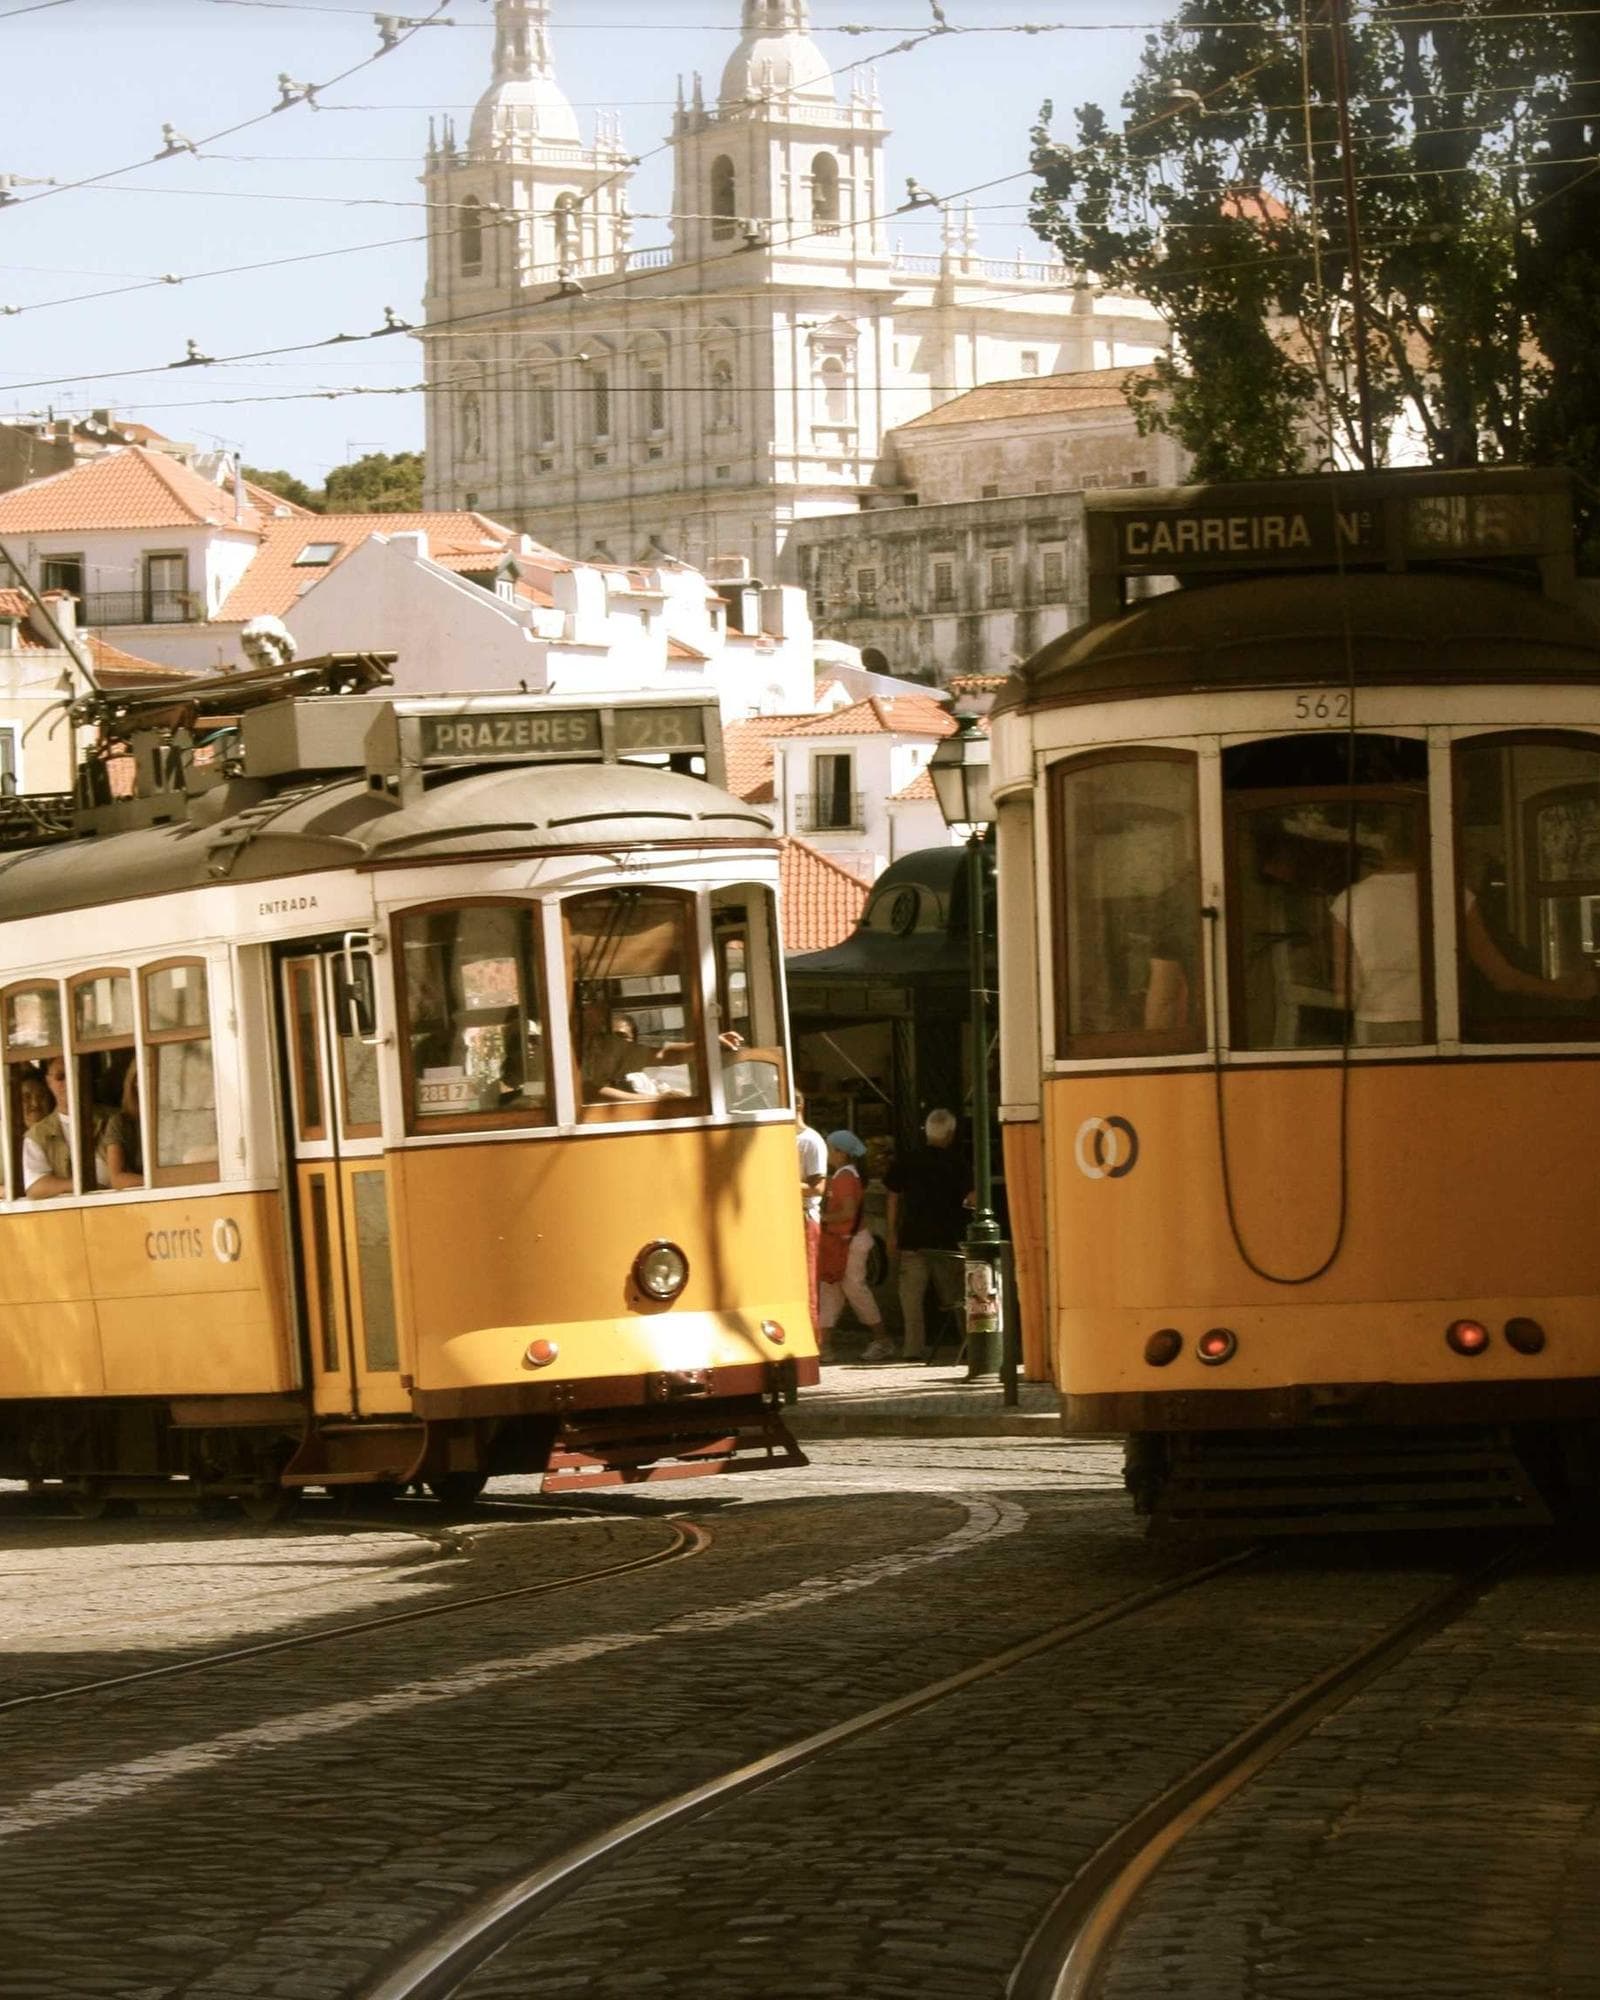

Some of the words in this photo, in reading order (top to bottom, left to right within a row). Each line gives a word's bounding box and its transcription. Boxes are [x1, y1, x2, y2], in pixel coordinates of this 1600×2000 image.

[1127, 515, 1311, 554] CARREIRA
[1296, 694, 1348, 718] 562
[436, 717, 586, 749] PRAZERES
[630, 714, 685, 746] 28
[259, 895, 318, 916] ENTRADA
[145, 1227, 202, 1260] carris
